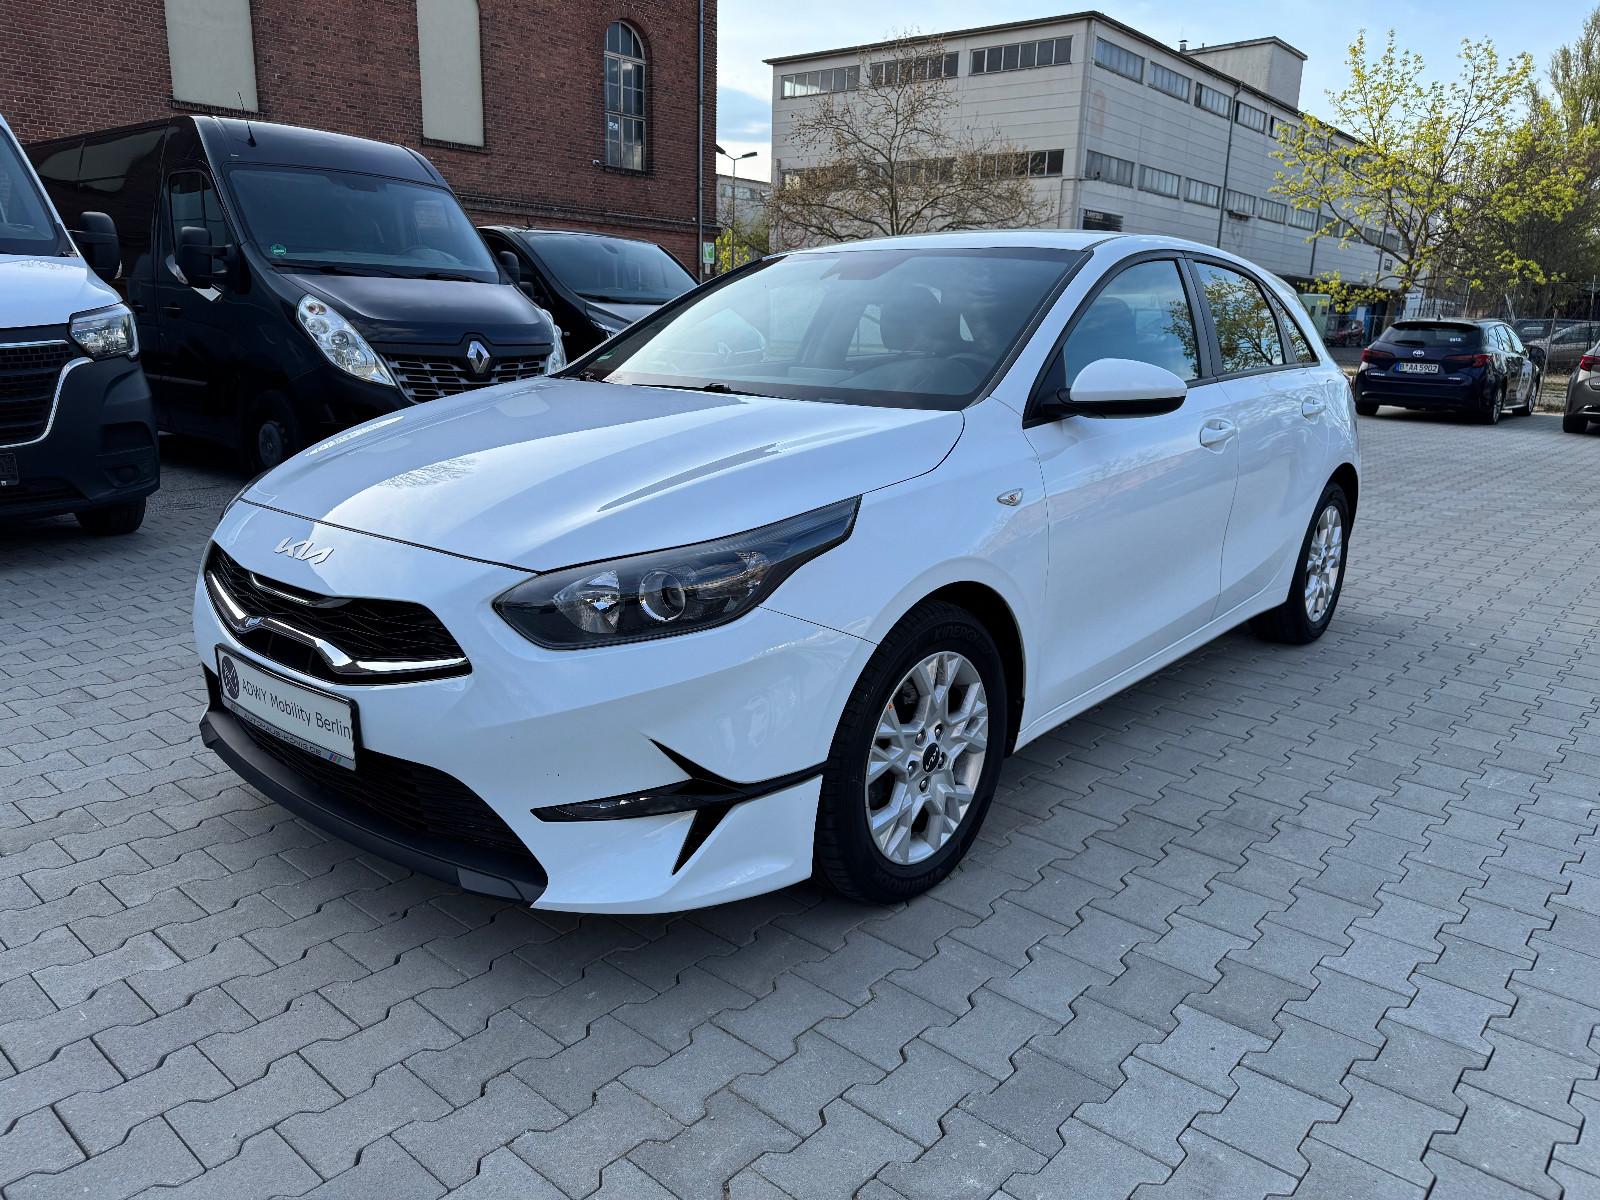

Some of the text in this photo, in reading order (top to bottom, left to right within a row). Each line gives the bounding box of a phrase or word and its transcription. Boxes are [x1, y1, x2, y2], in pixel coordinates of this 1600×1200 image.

[273, 536, 335, 565] KIA
[242, 678, 351, 740] ADWY Mobility Berlin
